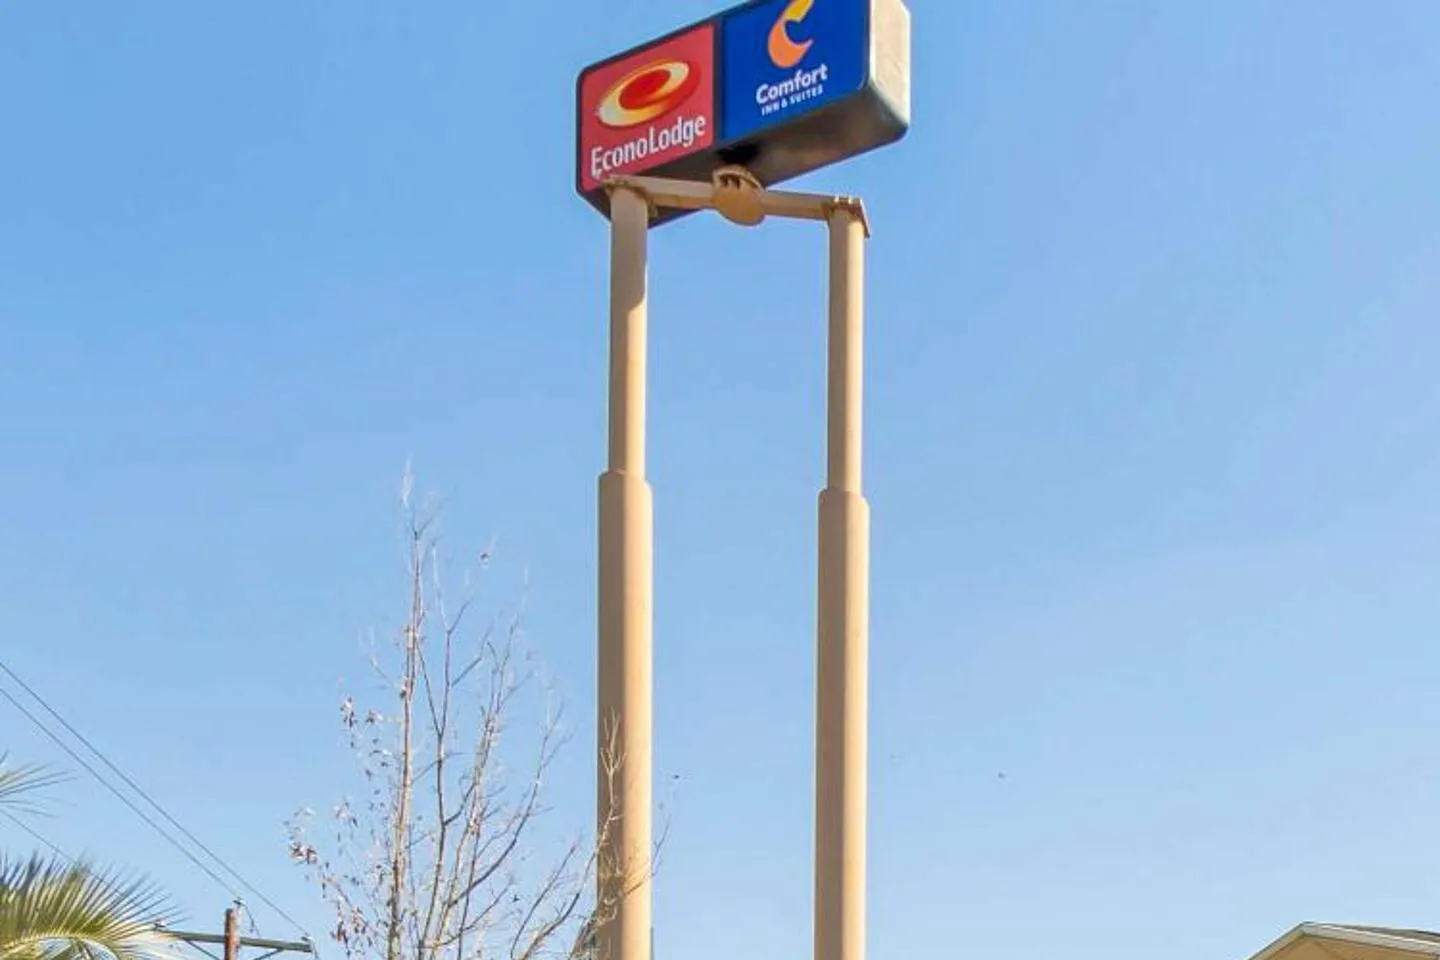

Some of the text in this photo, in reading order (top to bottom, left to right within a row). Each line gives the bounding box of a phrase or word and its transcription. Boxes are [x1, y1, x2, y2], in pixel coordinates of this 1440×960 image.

[756, 63, 828, 104] Comfort
[761, 100, 780, 116] INN
[790, 83, 823, 104] SUITES
[590, 115, 706, 180] EconoLodge
